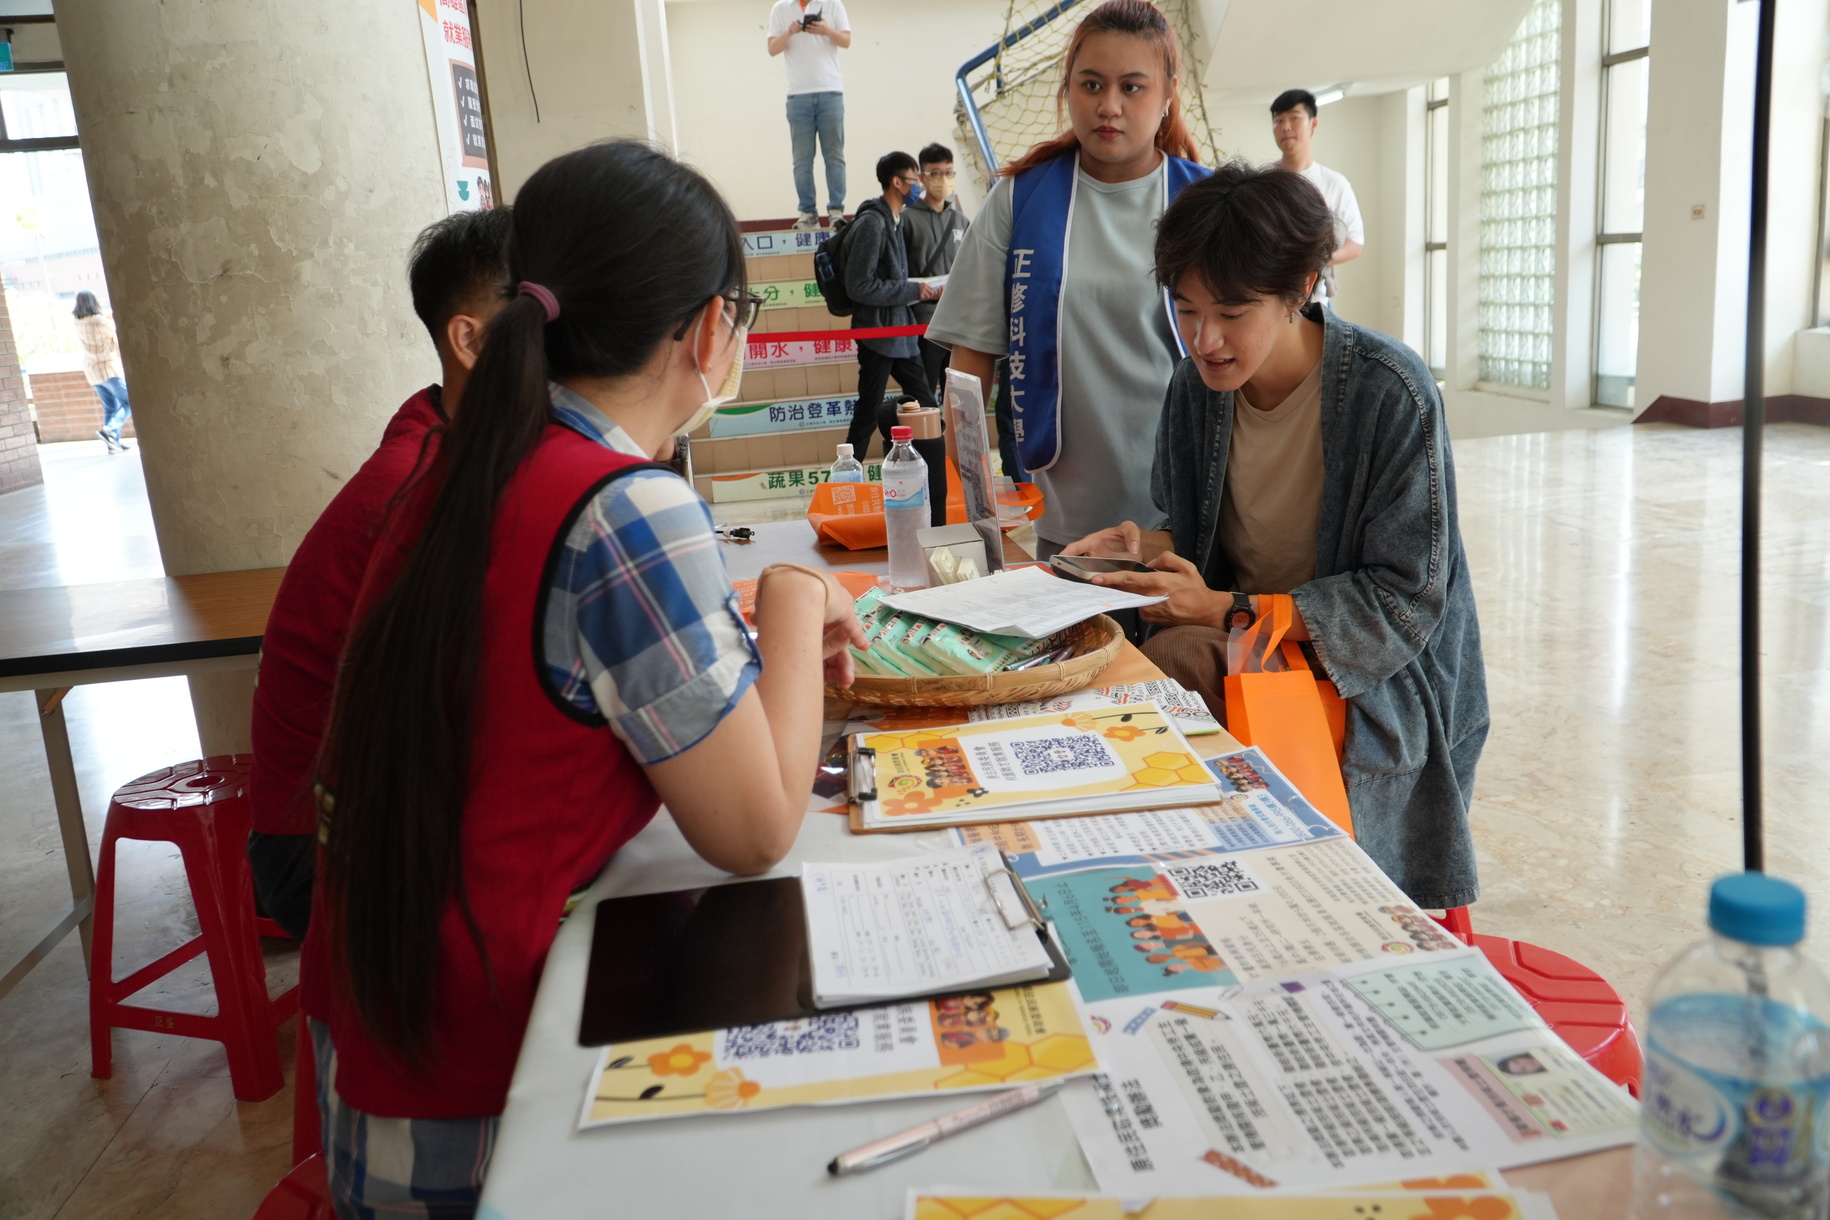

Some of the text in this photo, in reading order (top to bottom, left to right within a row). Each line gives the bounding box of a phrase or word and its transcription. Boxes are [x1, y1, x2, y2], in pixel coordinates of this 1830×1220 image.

[1010, 249, 1035, 446] 正修科技大學
